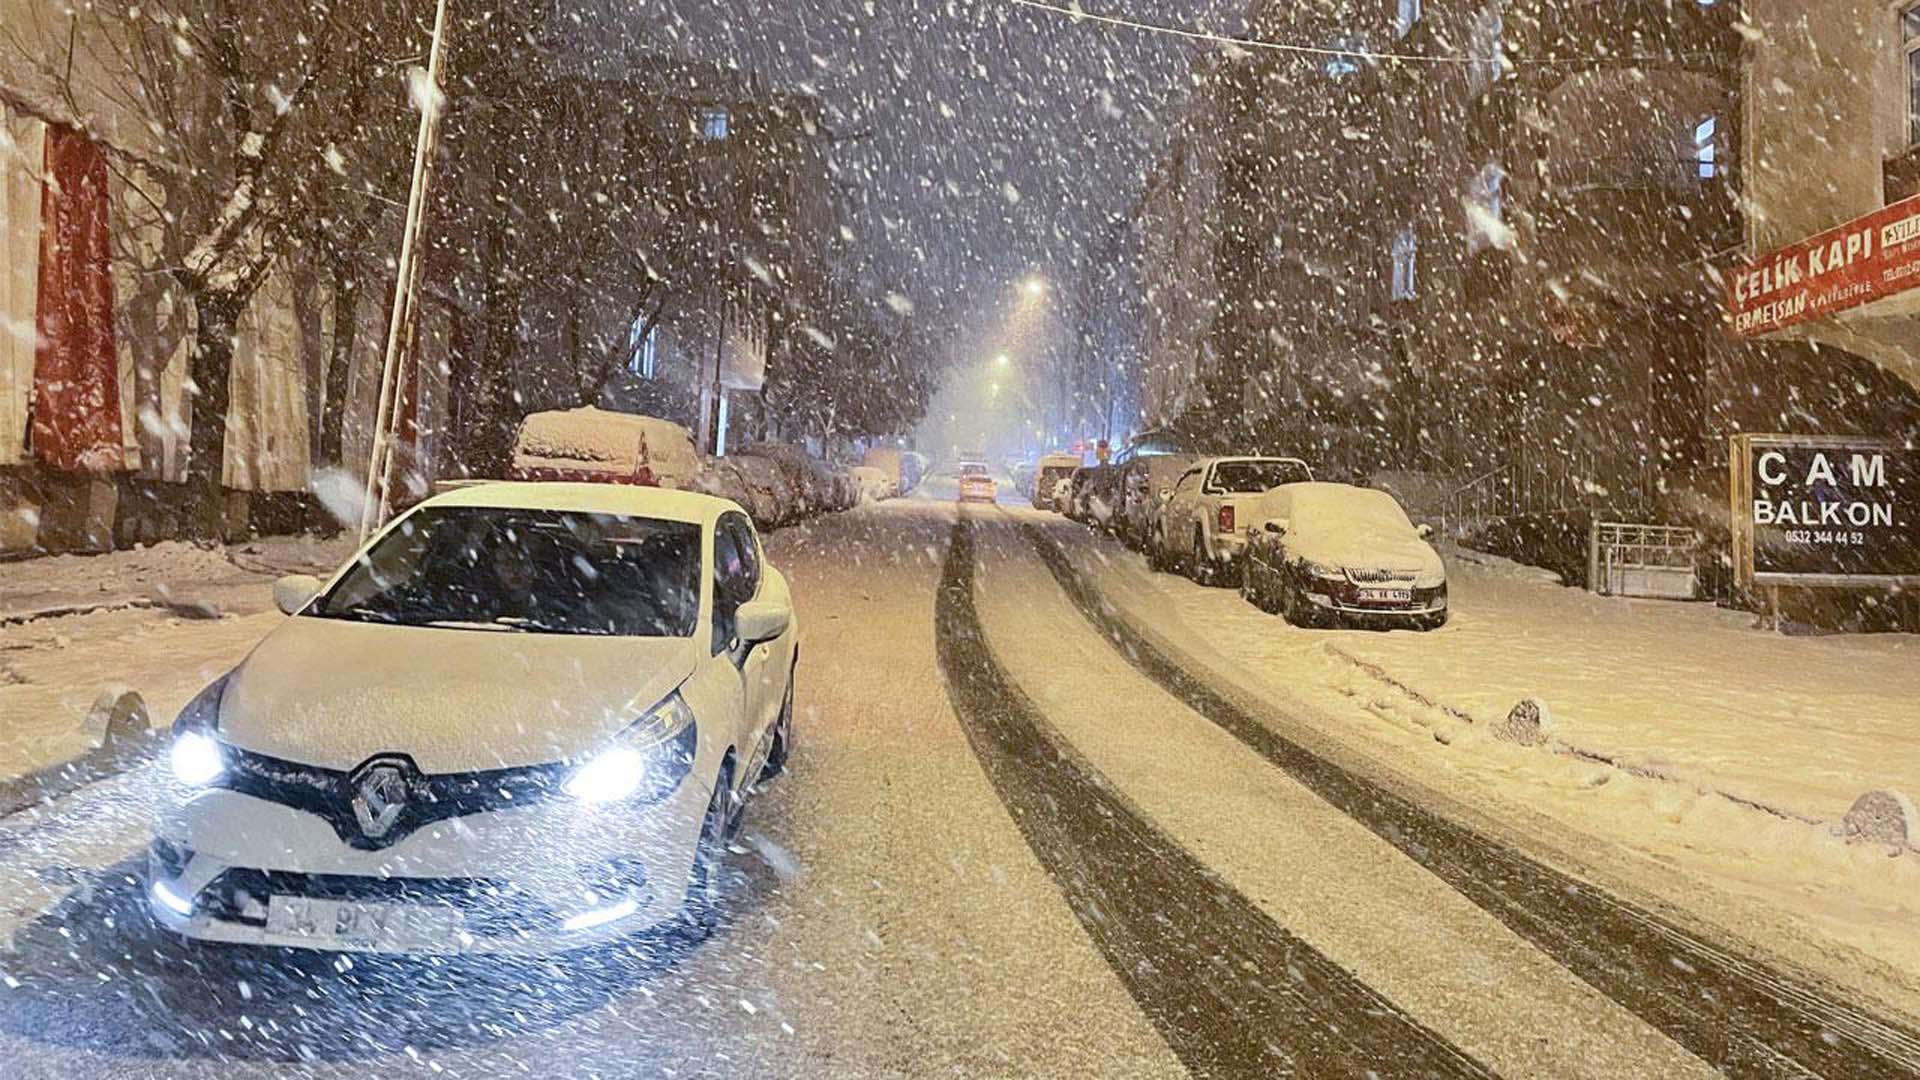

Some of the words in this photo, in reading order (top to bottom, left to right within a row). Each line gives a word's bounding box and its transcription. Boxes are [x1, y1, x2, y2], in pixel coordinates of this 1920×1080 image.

[1734, 254, 1801, 309] ÇELİK
[1809, 227, 1872, 279] KAPI
[1753, 500, 1893, 527] BALKON
[1785, 530, 1811, 543] 0532
